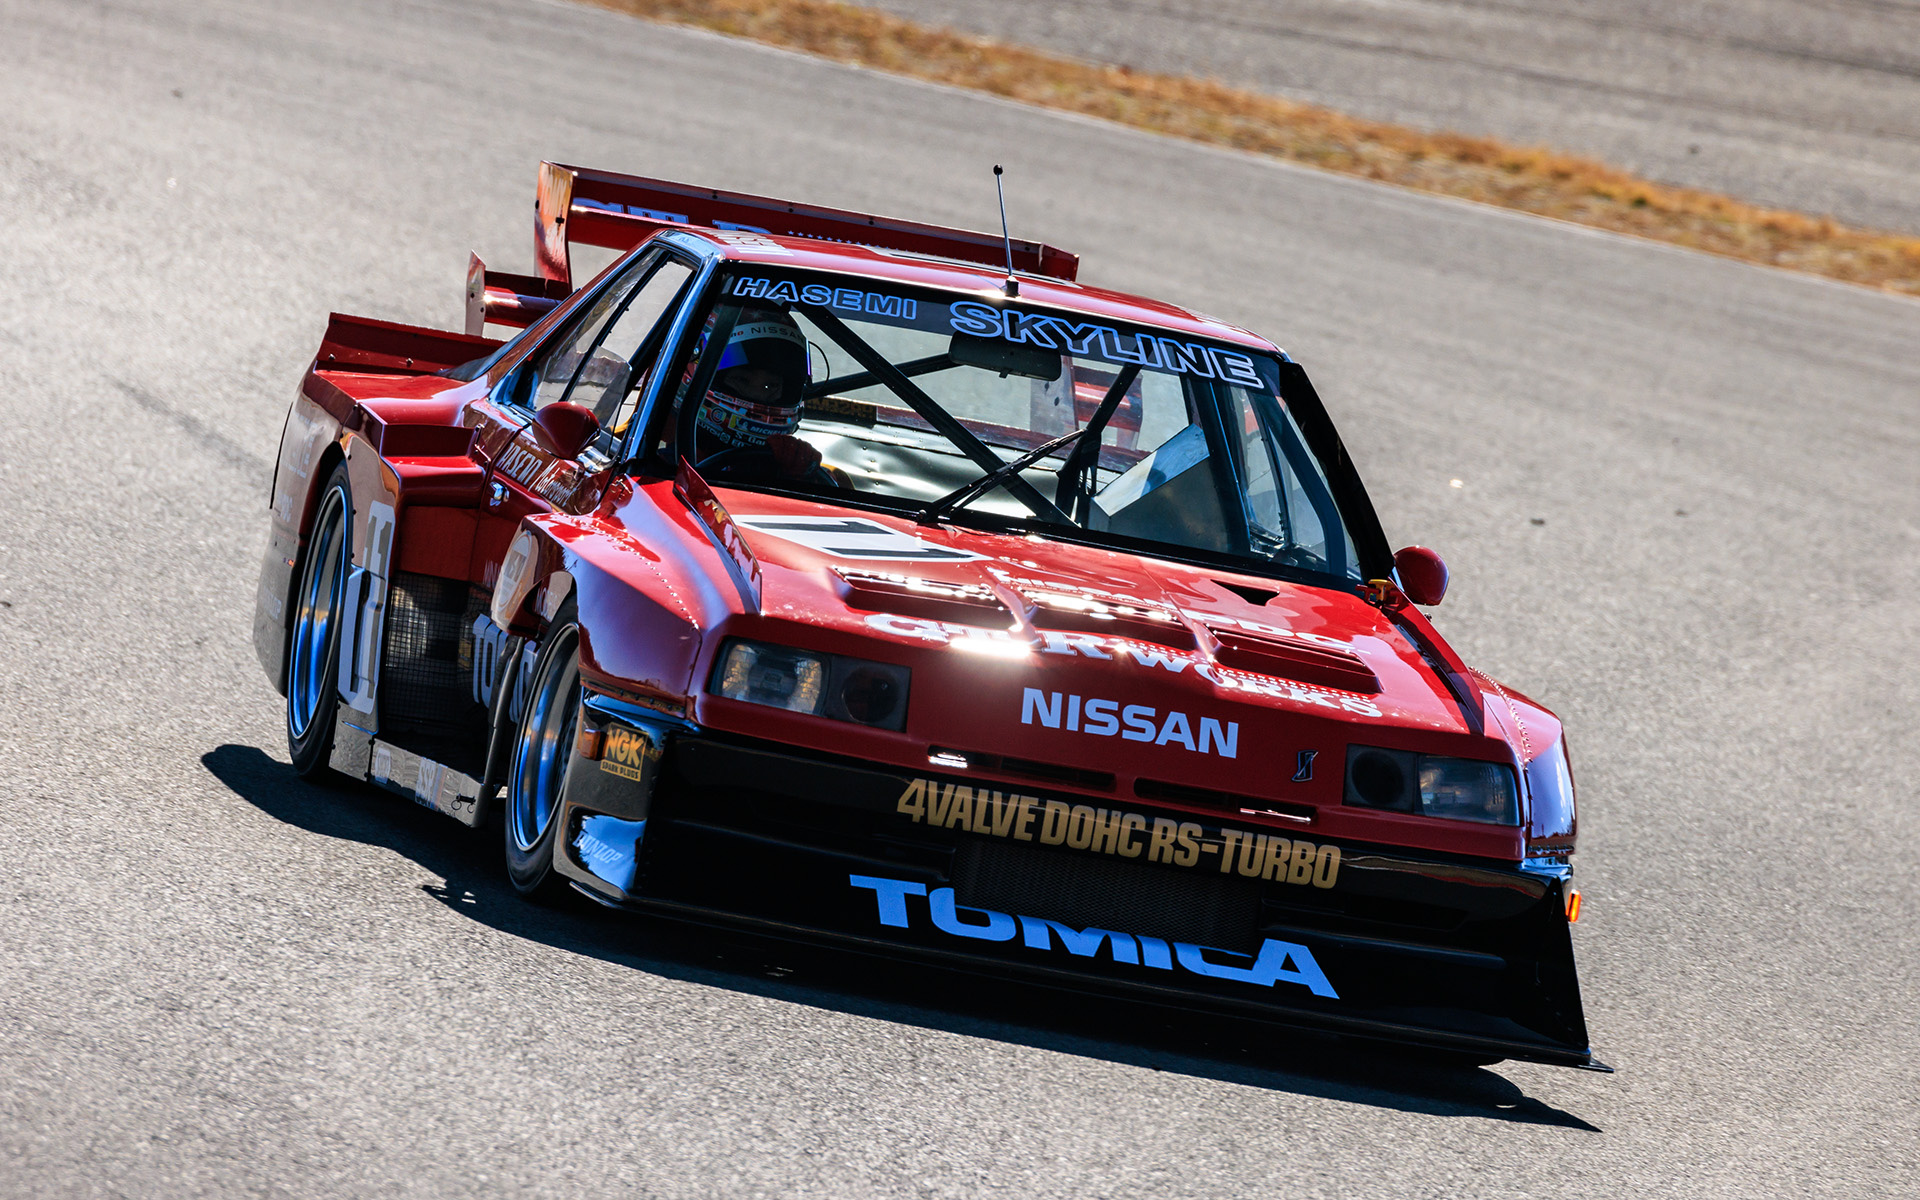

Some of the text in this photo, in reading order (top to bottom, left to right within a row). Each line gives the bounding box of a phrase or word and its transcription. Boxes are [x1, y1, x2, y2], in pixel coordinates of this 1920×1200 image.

[733, 276, 1265, 390] HASEMI SKYLINE
[1126, 646, 1383, 718] WORKS
[605, 728, 645, 769] NGK
[1021, 687, 1239, 759] NISSAN
[602, 760, 640, 780] SPARK PLUGS
[572, 830, 624, 864] DUNLOP
[897, 778, 1341, 890] 4VALVE DOHC RS-TURBO
[849, 874, 1340, 1000] TOMICA
